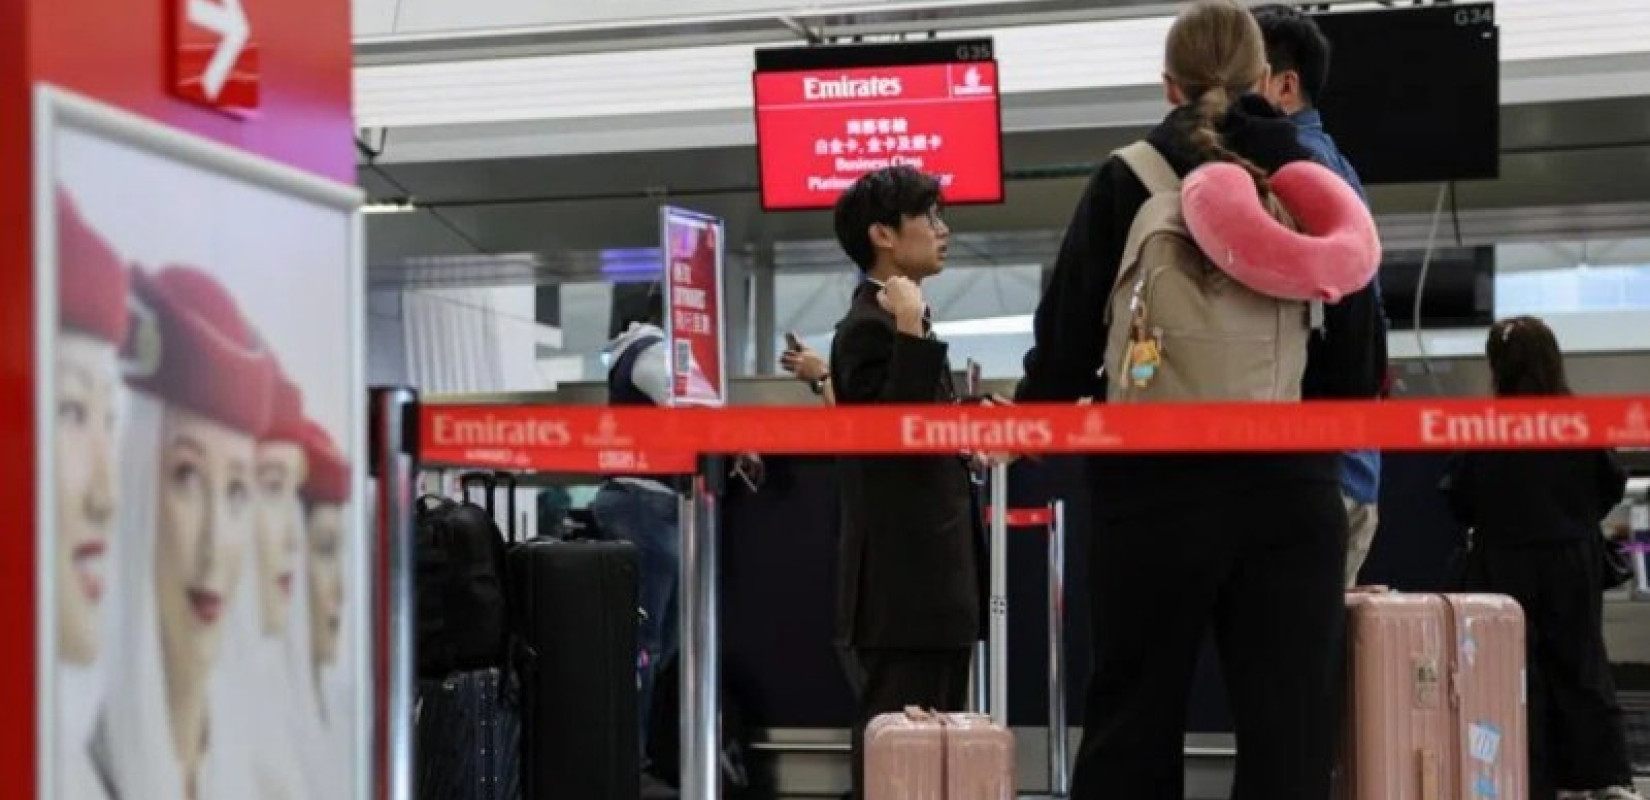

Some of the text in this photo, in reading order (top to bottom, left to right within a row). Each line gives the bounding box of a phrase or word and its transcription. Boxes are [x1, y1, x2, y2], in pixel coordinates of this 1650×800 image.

[1454, 6, 1492, 26] G34
[956, 43, 990, 60] G35
[803, 75, 902, 100] Emirates
[432, 412, 571, 446] Emirates
[901, 413, 1052, 448] Emirates
[1420, 408, 1590, 445] Emirates
